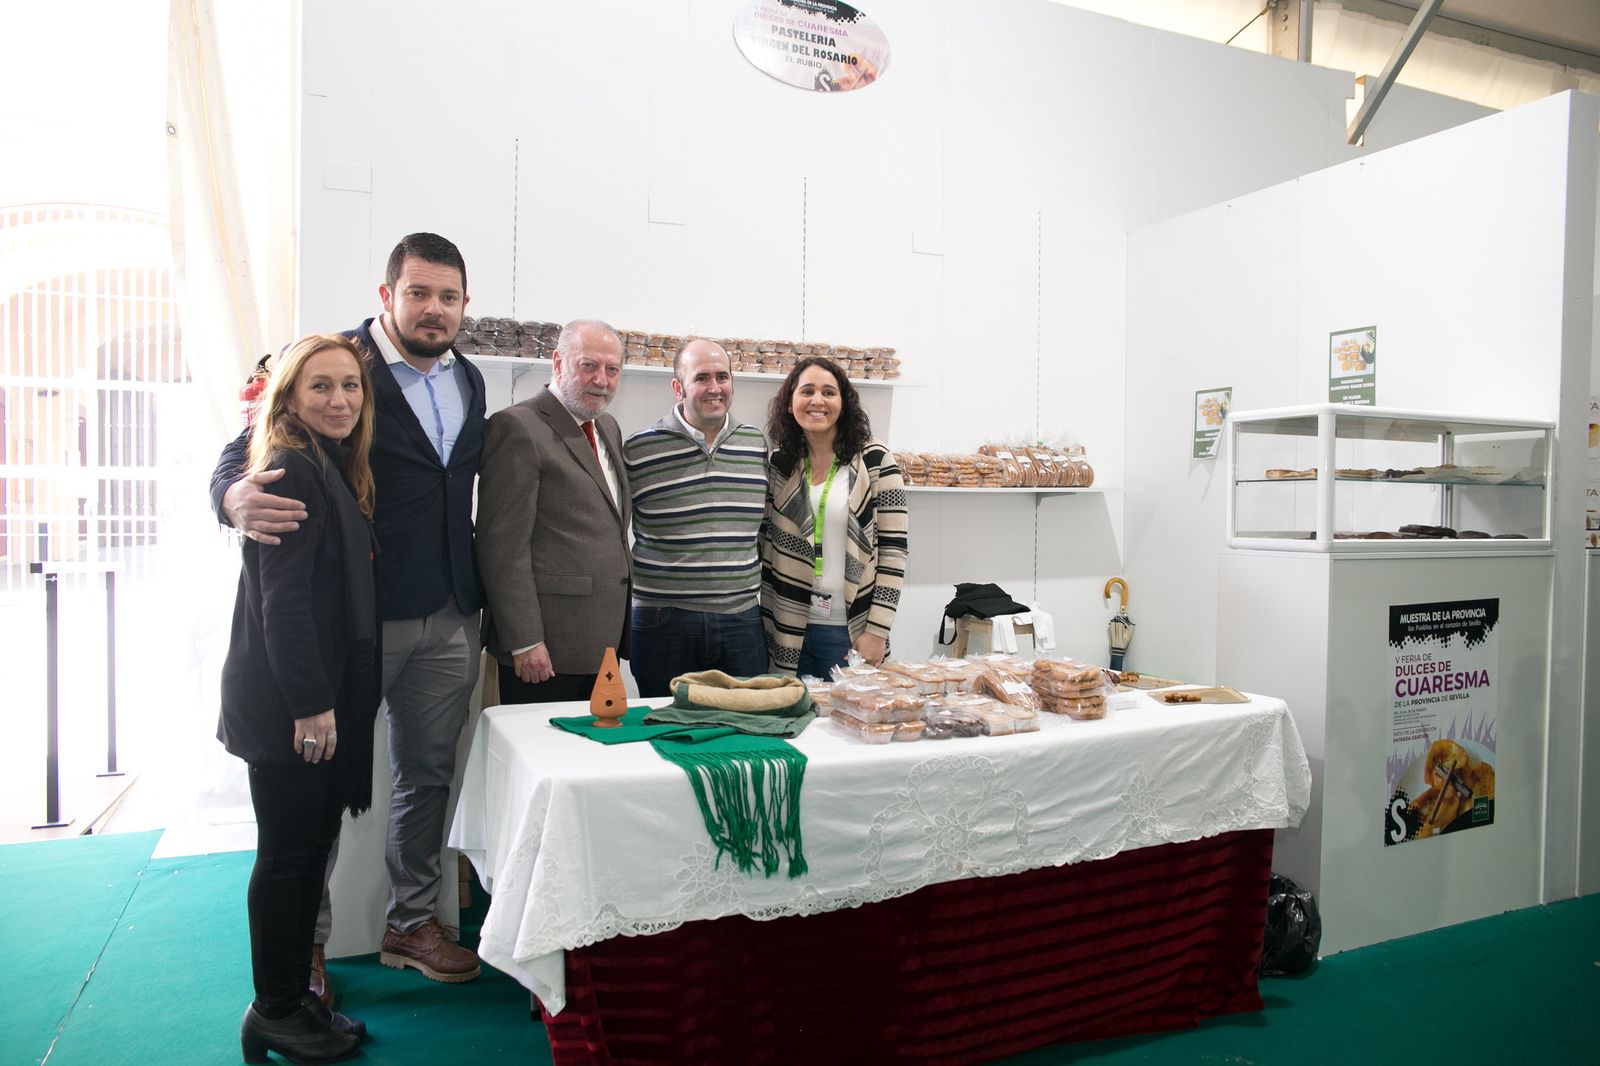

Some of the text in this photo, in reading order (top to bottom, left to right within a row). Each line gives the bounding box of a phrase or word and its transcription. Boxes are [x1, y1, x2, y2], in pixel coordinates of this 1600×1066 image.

[754, 11, 785, 24] DULCES
[797, 20, 849, 38] CUARESMA
[771, 24, 837, 48] PASTELERIA
[751, 35, 858, 66] VIRGEN DEL ROSARIO
[785, 55, 822, 69] EL RUBIO
[1400, 608, 1486, 624] MUESTRA DE LA PROVINCIA
[1416, 623, 1432, 631] Pueblos
[1395, 653, 1432, 664] V FERIA DE
[1395, 661, 1451, 677] DULCES DE
[1395, 669, 1490, 698] CUARESMA
[1411, 696, 1440, 706] PROVINCIA
[1441, 694, 1448, 702] DE
[1448, 692, 1470, 701] SEVILLA
[1390, 798, 1407, 842] S
